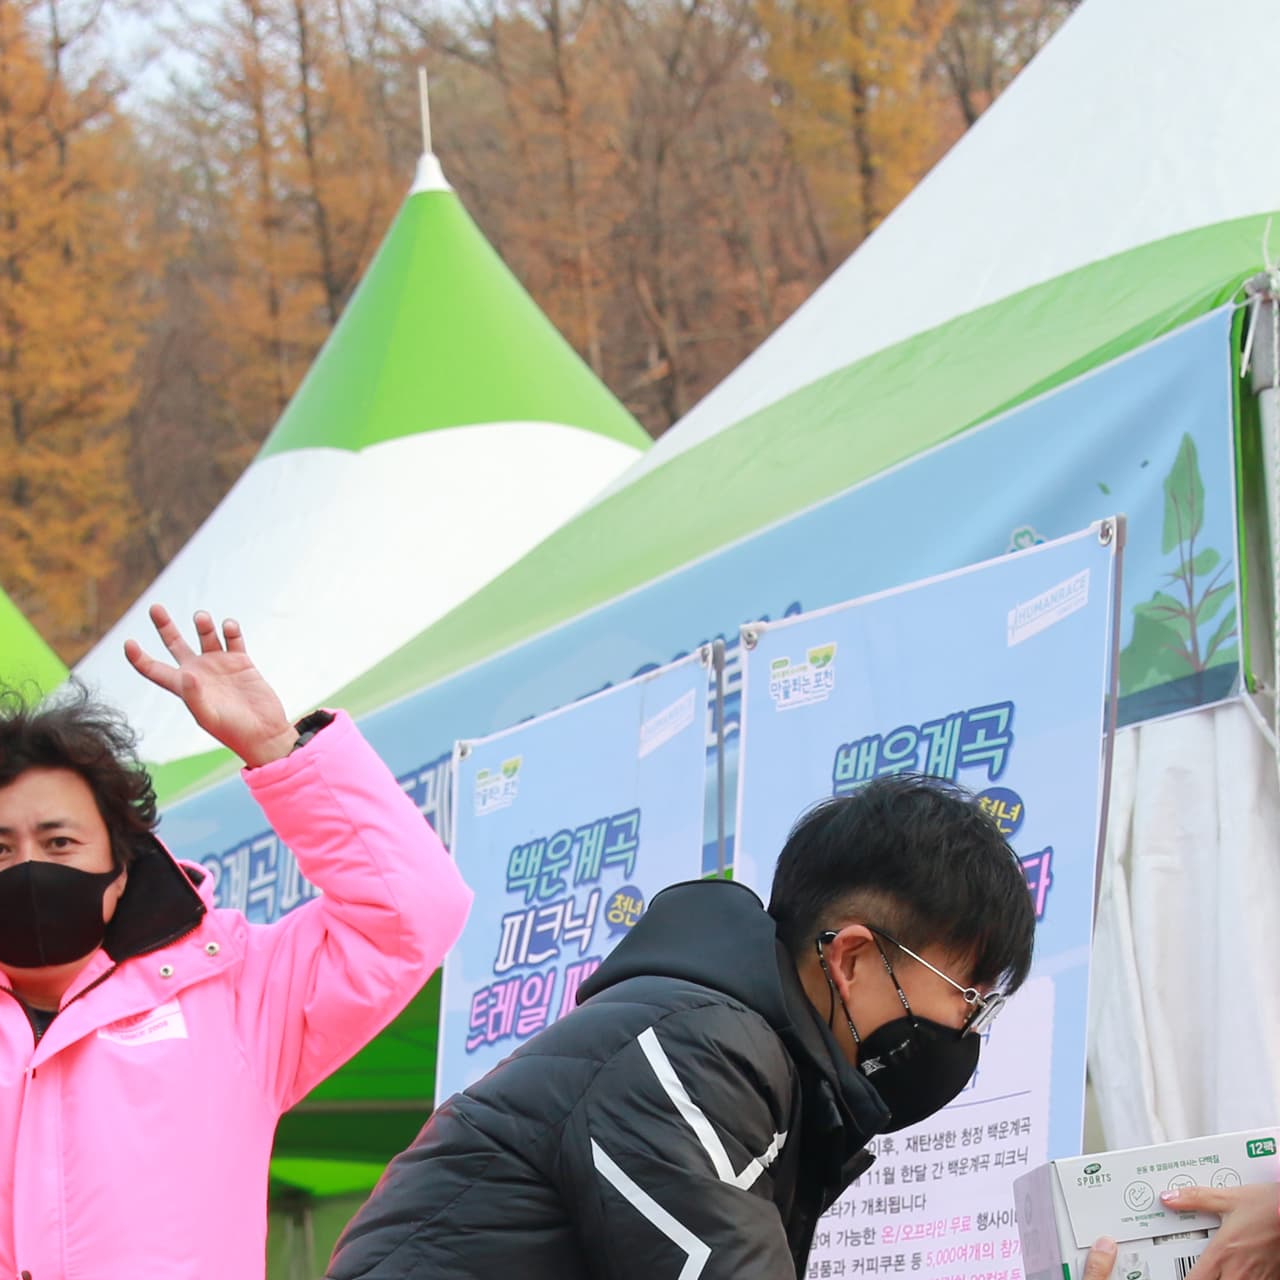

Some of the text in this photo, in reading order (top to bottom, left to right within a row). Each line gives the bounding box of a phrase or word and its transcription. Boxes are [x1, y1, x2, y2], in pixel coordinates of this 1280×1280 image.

[507, 810, 640, 903] 백운계곡
[608, 894, 645, 928] 청년
[494, 889, 602, 975] 피크닉
[466, 967, 557, 1052] 트레일
[905, 1130, 957, 1153] 재탄생한
[961, 1126, 983, 1147] 청정
[987, 1116, 1031, 1141] 백운계곡
[867, 1166, 895, 1186] 11월
[900, 1163, 928, 1183] 한달
[931, 1162, 945, 1180] 간
[947, 1154, 991, 1177] 백운계곡
[993, 1147, 1028, 1168] 피크닉
[1077, 1173, 1112, 1187] SPORTS
[860, 1193, 927, 1216] 개최됩니다
[836, 1227, 877, 1247] 가능한
[881, 1219, 947, 1246] 온/오프라인
[950, 1215, 972, 1234] 무료
[976, 1208, 1018, 1232] 행사이
[851, 1254, 906, 1275] 커피쿠폰
[910, 1252, 922, 1272] 등
[926, 1241, 995, 1268] 5,000여개의
